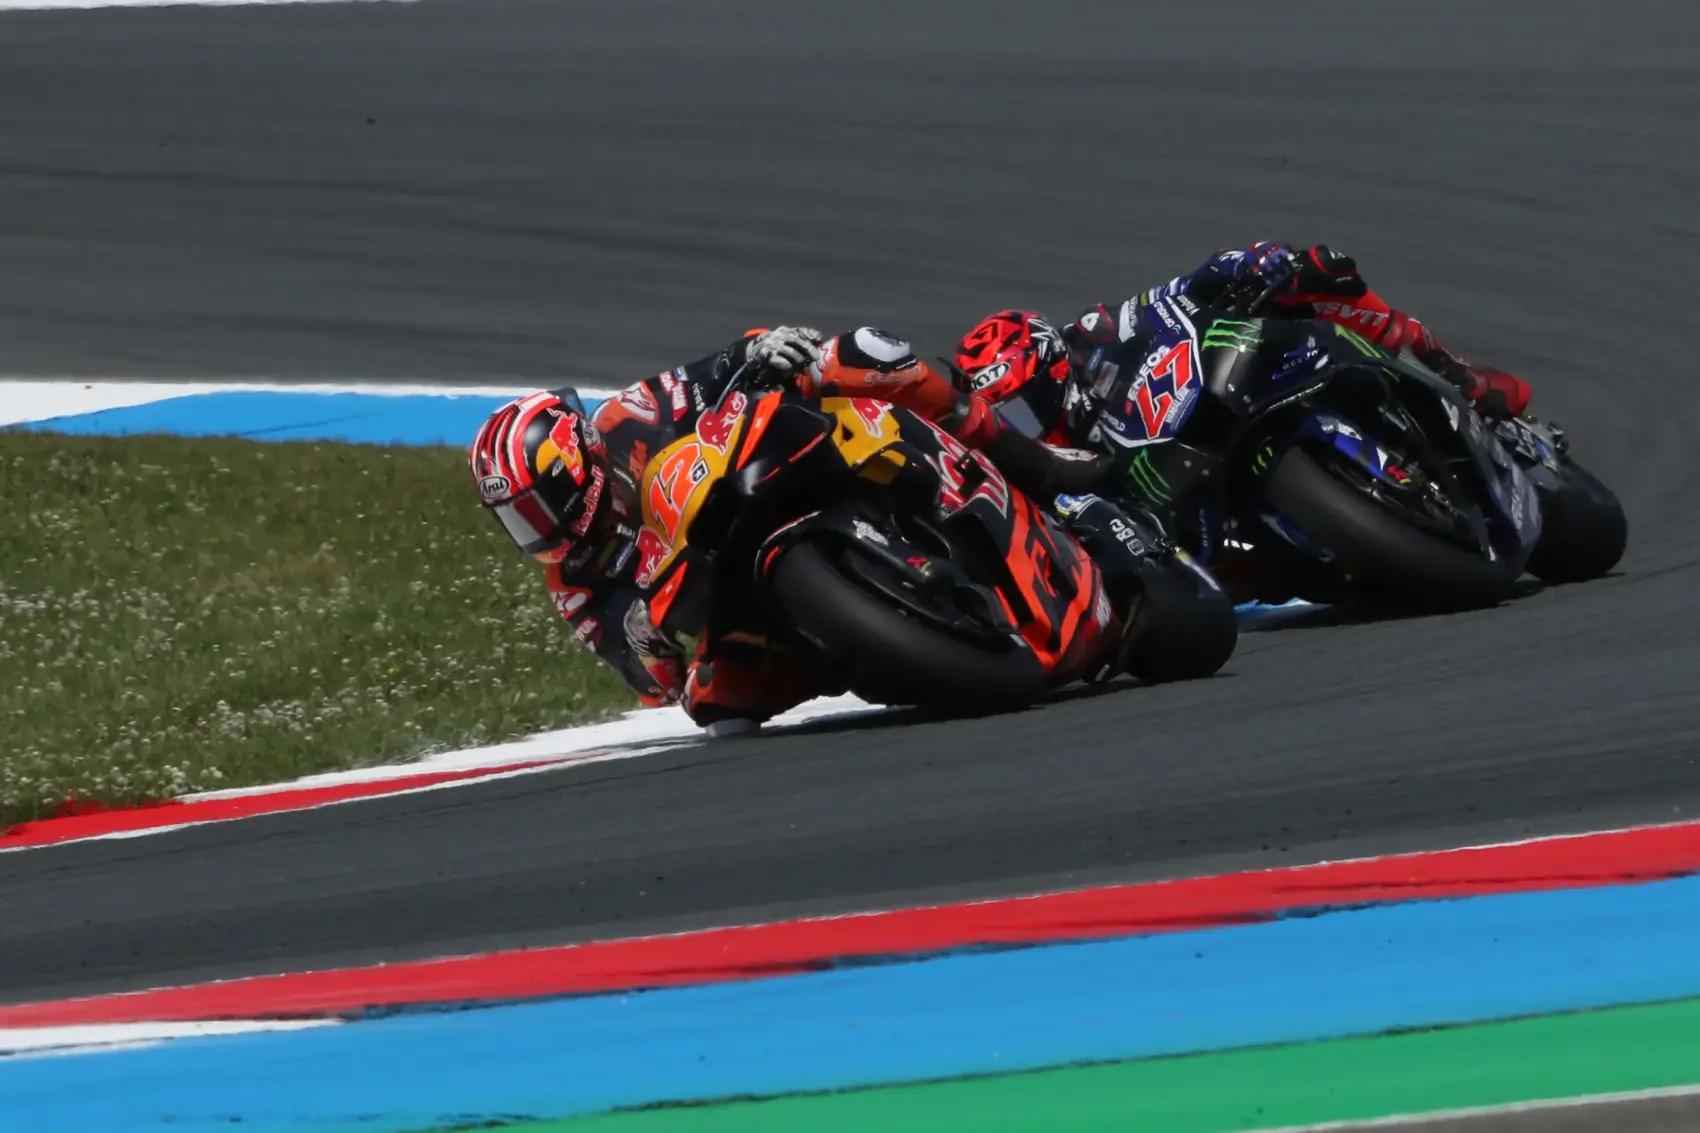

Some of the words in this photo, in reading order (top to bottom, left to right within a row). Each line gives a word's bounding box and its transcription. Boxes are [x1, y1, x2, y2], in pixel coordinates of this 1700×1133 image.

[971, 362, 1005, 390] KYT
[1127, 345, 1171, 401] ENEOS
[482, 478, 504, 496] Arai
[586, 464, 604, 502] Bull
[650, 442, 702, 545] 12
